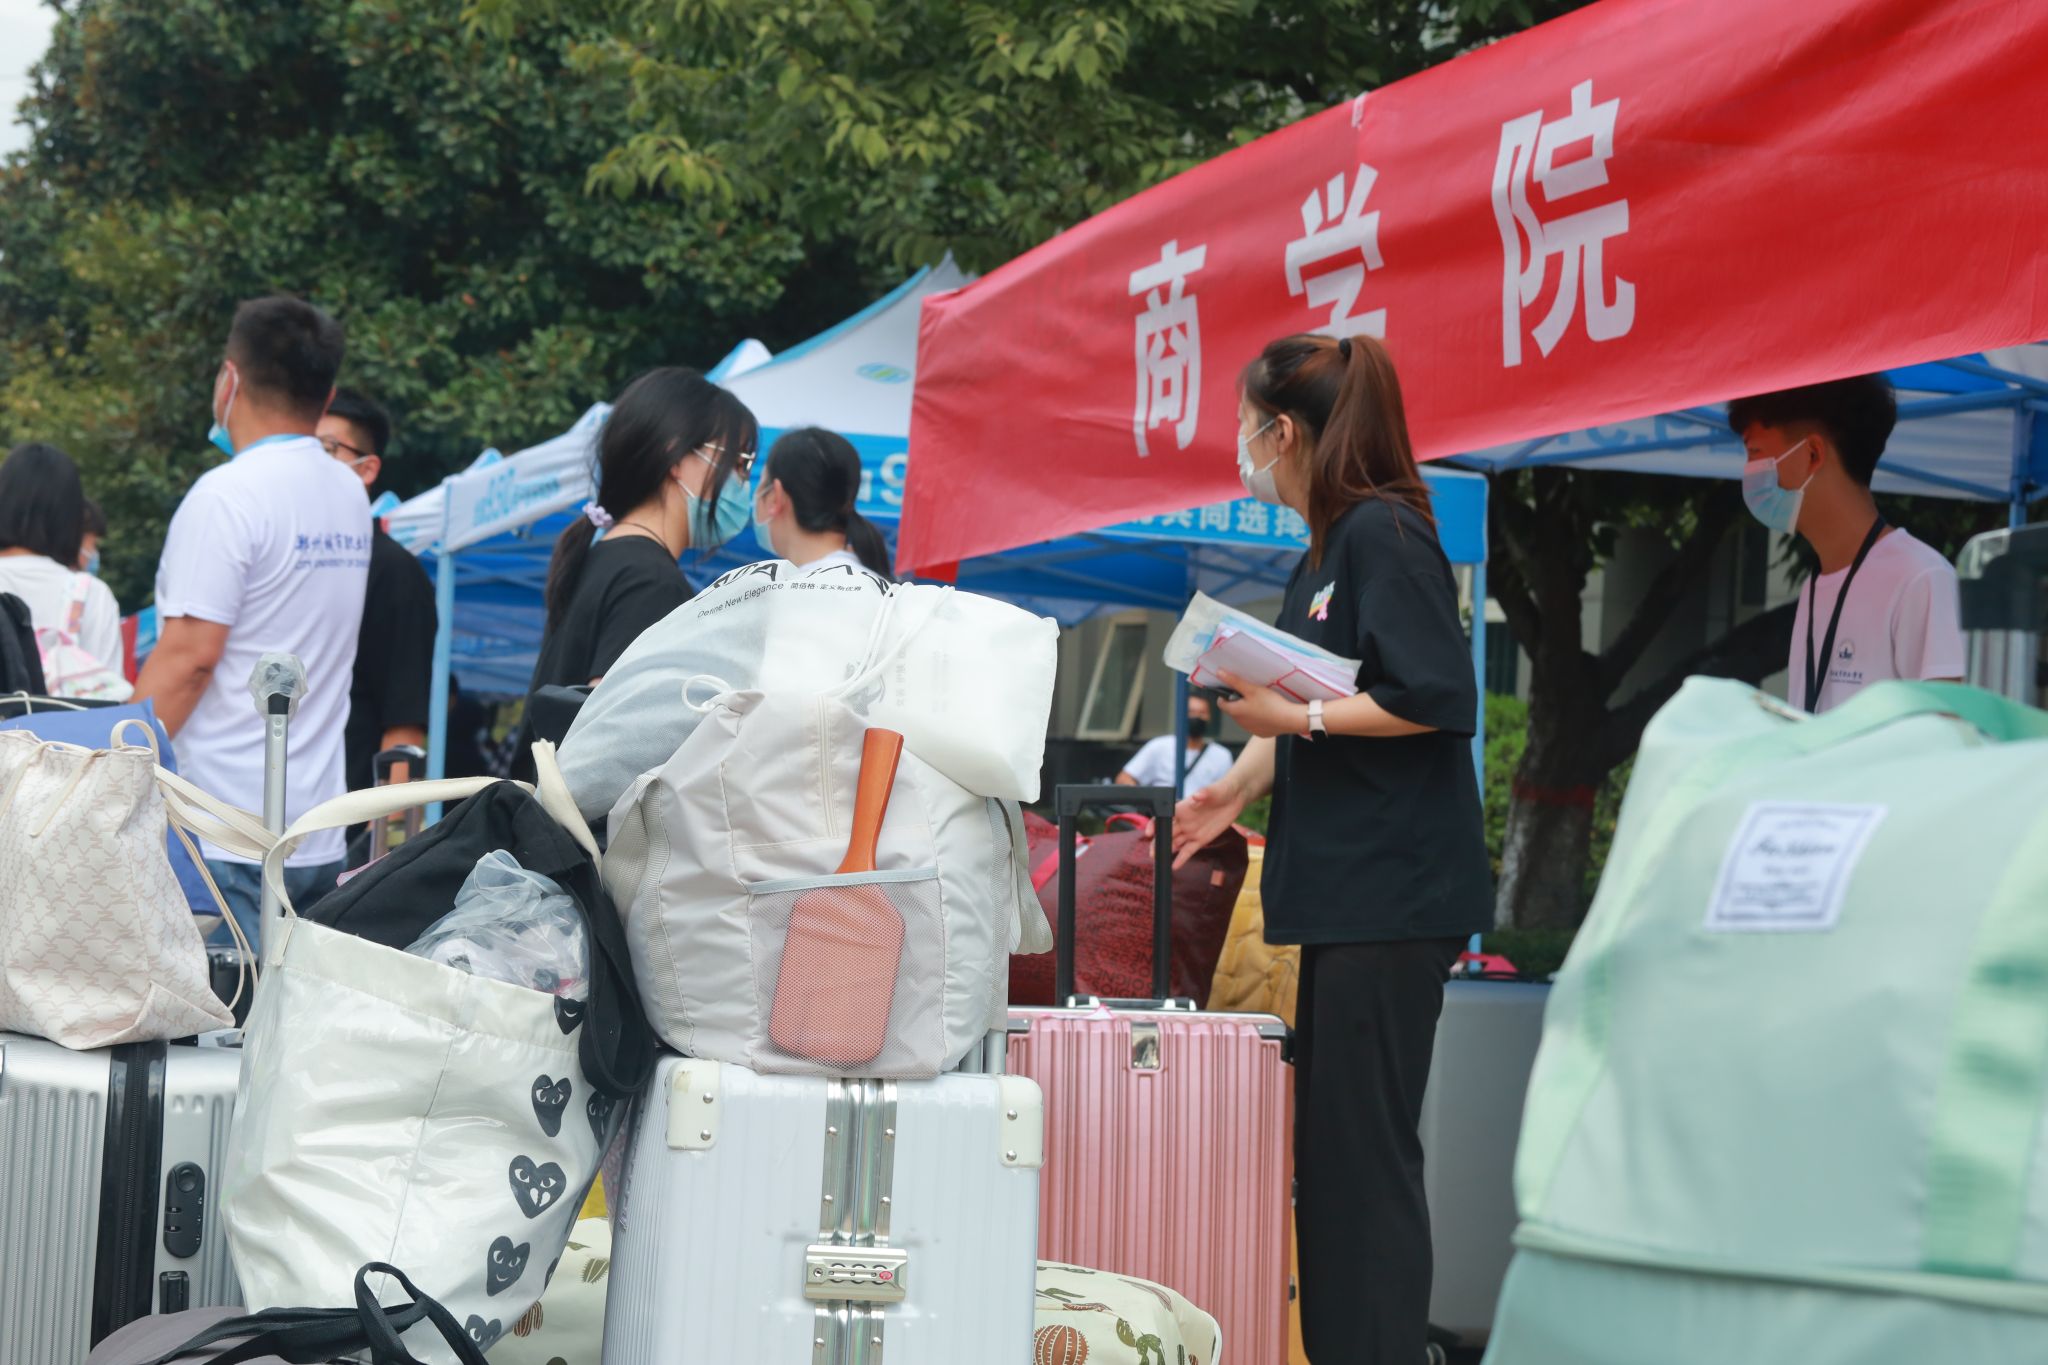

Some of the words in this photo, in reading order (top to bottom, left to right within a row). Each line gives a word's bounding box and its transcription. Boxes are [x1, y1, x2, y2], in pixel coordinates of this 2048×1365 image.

[1128, 78, 1636, 457] 商学院
[724, 595, 742, 609] New
[744, 582, 784, 600] Elegance
